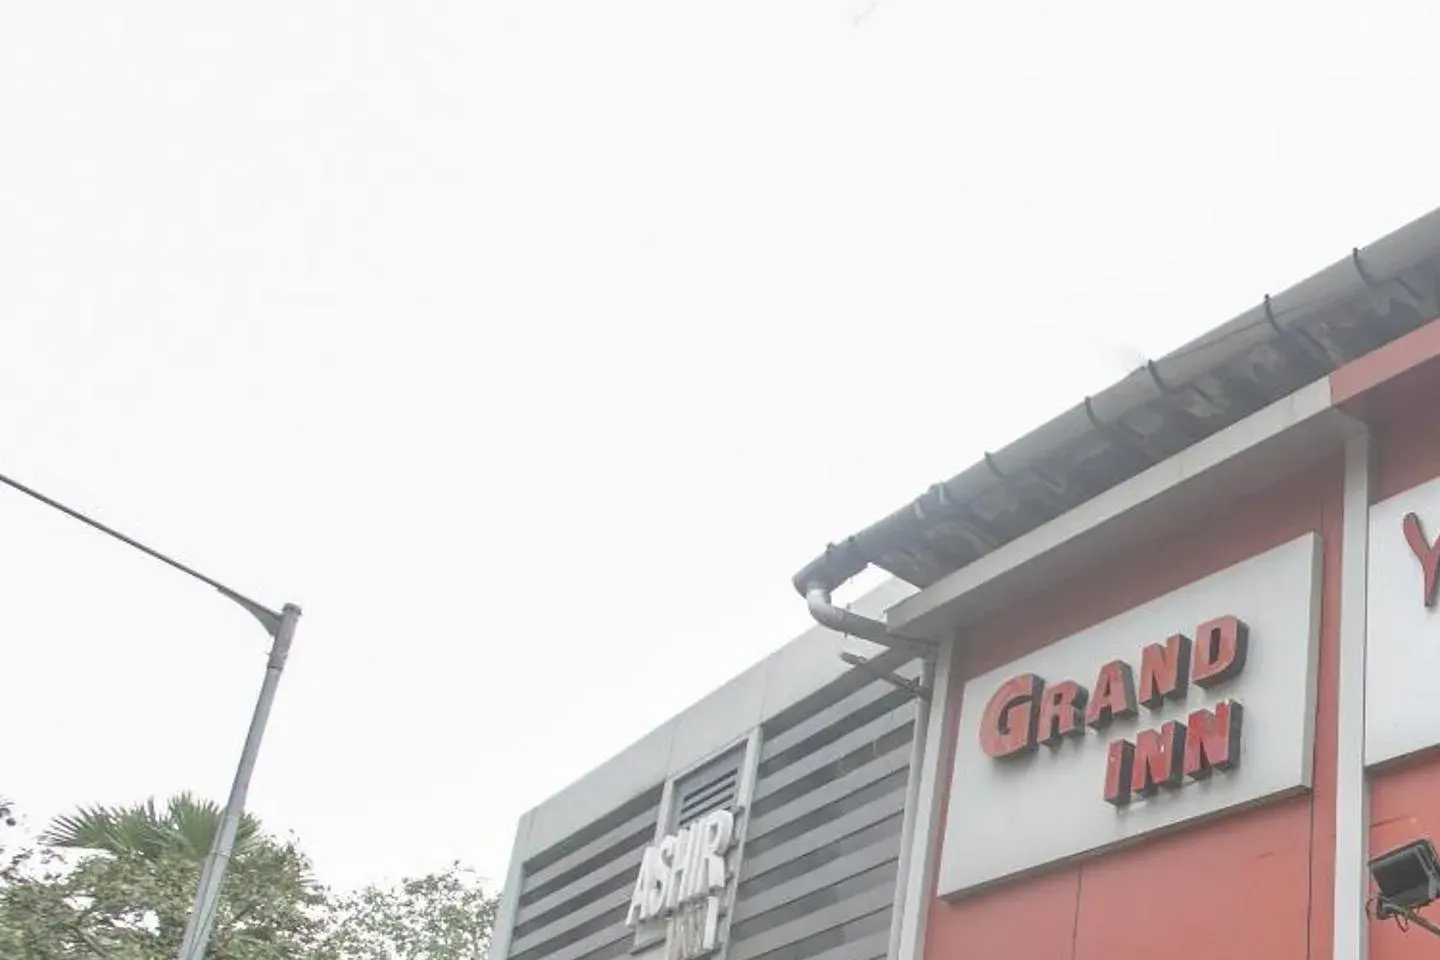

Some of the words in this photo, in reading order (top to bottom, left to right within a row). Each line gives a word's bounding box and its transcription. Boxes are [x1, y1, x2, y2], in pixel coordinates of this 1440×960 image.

[979, 614, 1249, 759] GRAND
[1104, 699, 1243, 806] INN
[625, 810, 734, 927] ASHIR
